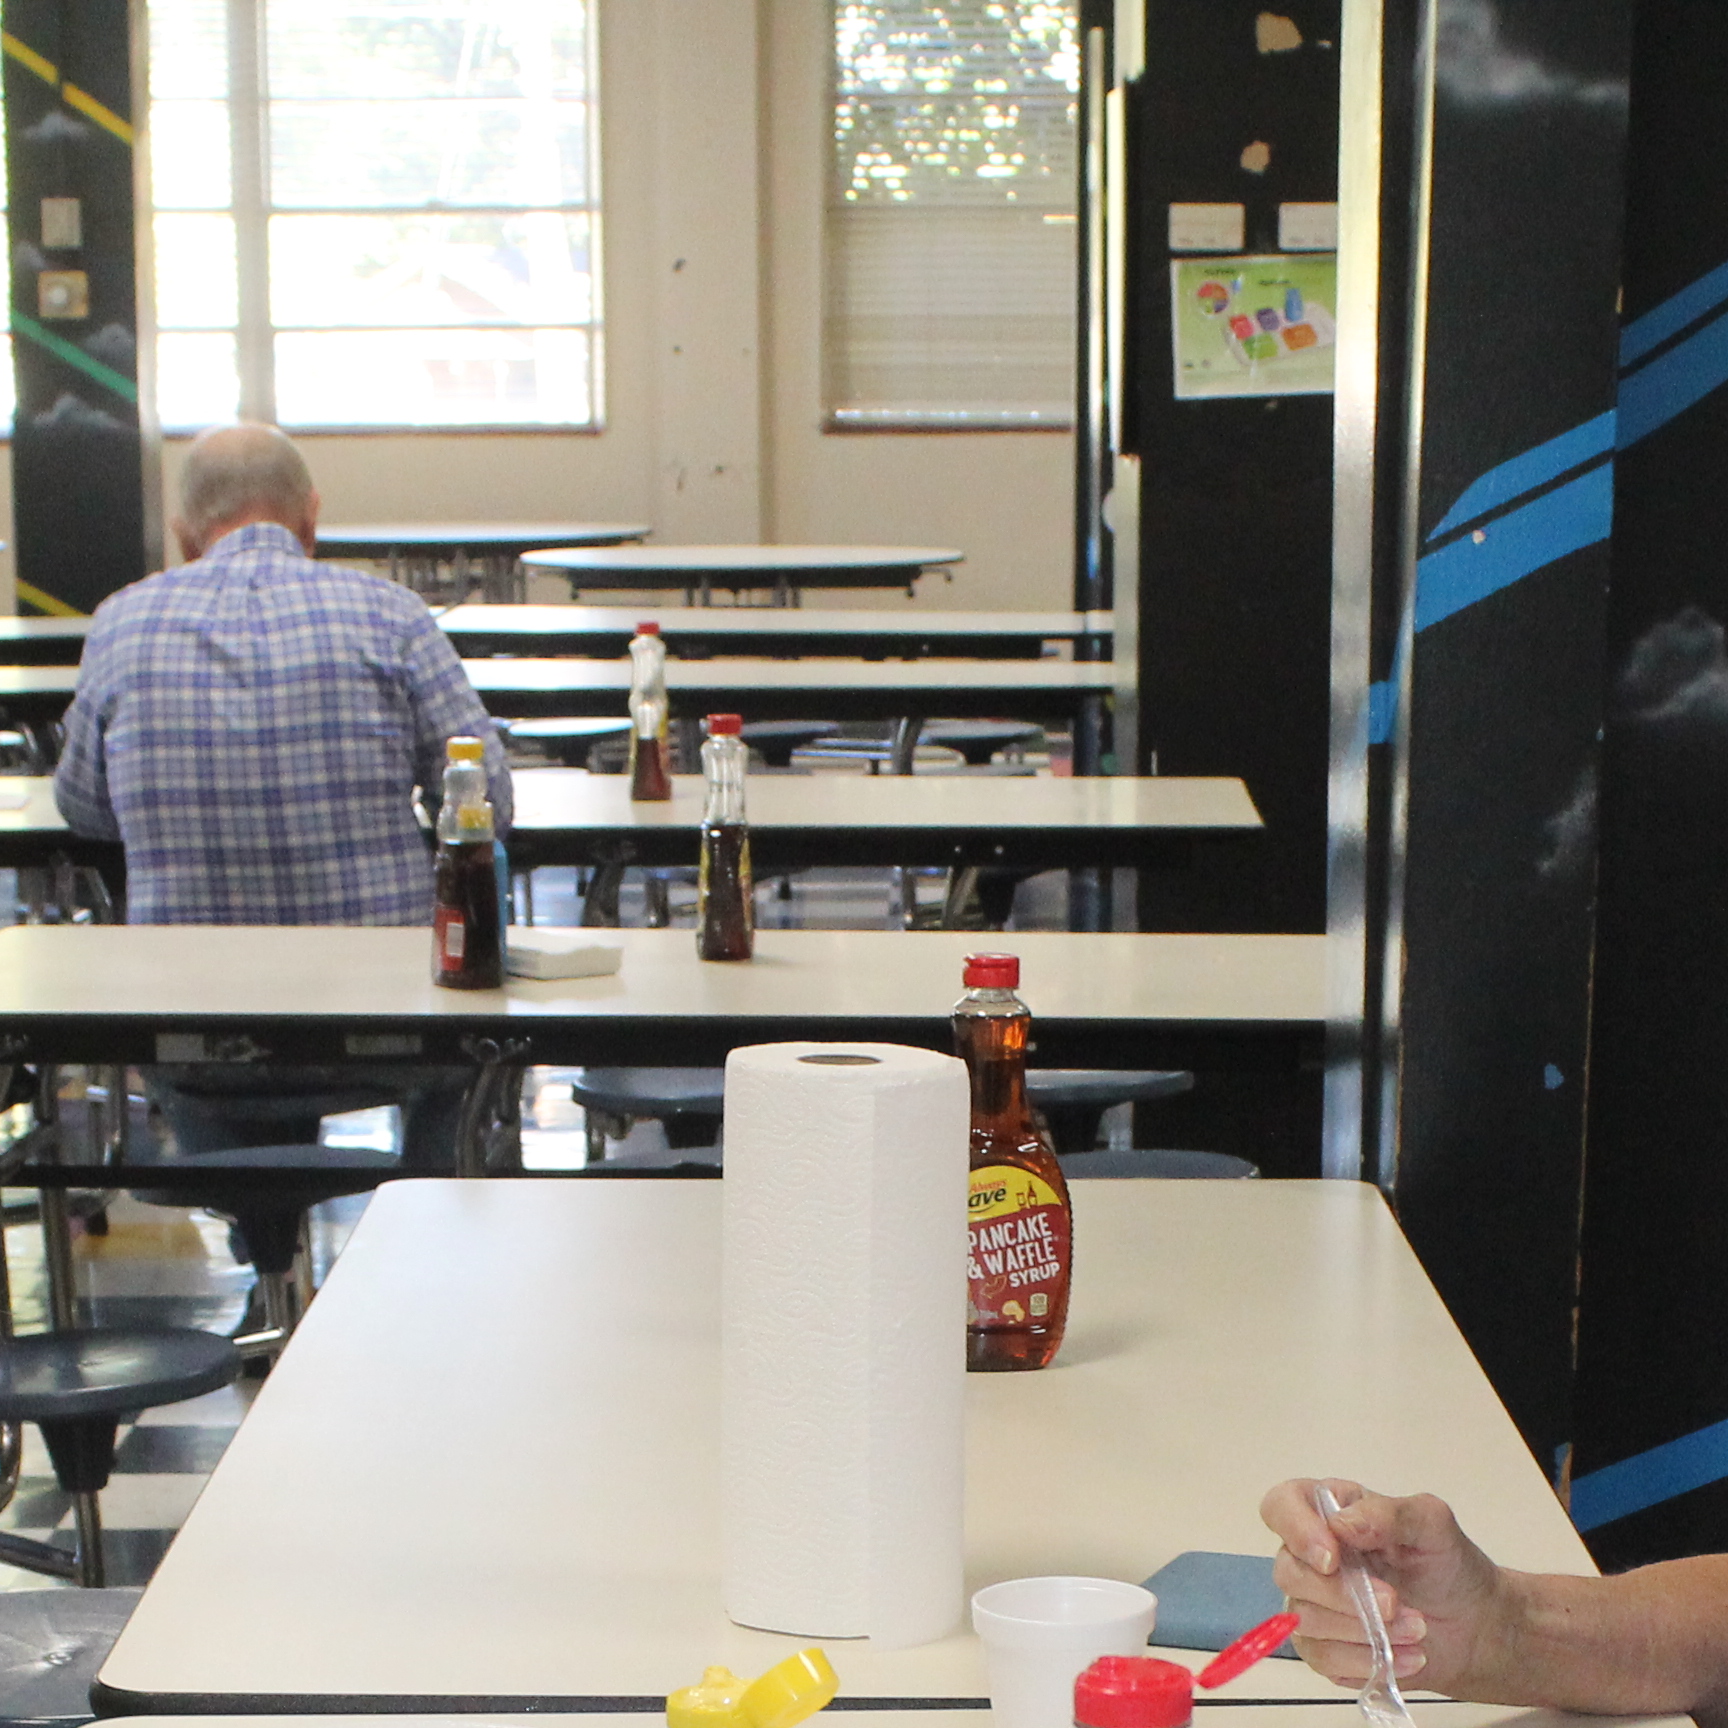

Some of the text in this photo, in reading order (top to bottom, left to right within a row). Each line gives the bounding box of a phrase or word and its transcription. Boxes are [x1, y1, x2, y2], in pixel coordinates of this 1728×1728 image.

[968, 1188, 1007, 1207] ave
[968, 1212, 1052, 1254] PANCAKE
[968, 1237, 1056, 1279] & WAFFLE
[1009, 1262, 1060, 1288] SYRUP
